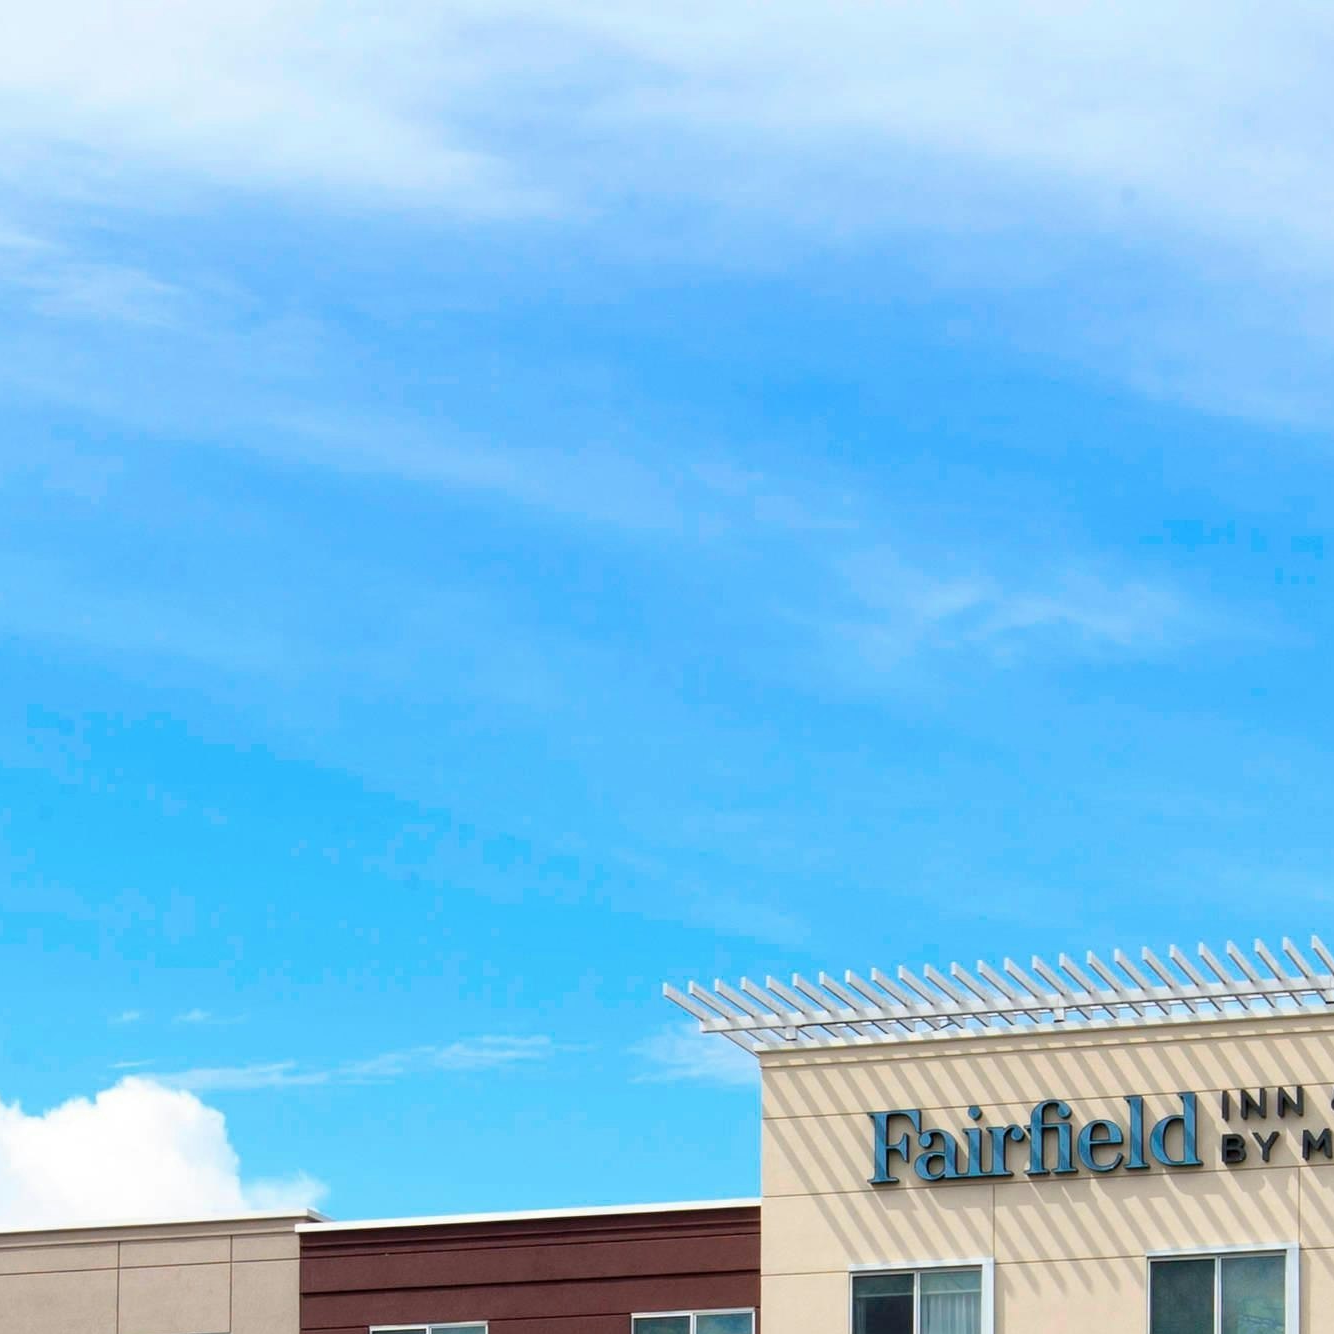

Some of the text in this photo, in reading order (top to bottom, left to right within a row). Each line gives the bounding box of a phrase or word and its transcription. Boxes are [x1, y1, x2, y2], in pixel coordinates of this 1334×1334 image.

[1221, 1085, 1304, 1121] INN
[868, 1091, 1203, 1184] Fairfield
[1221, 1131, 1279, 1164] BY
